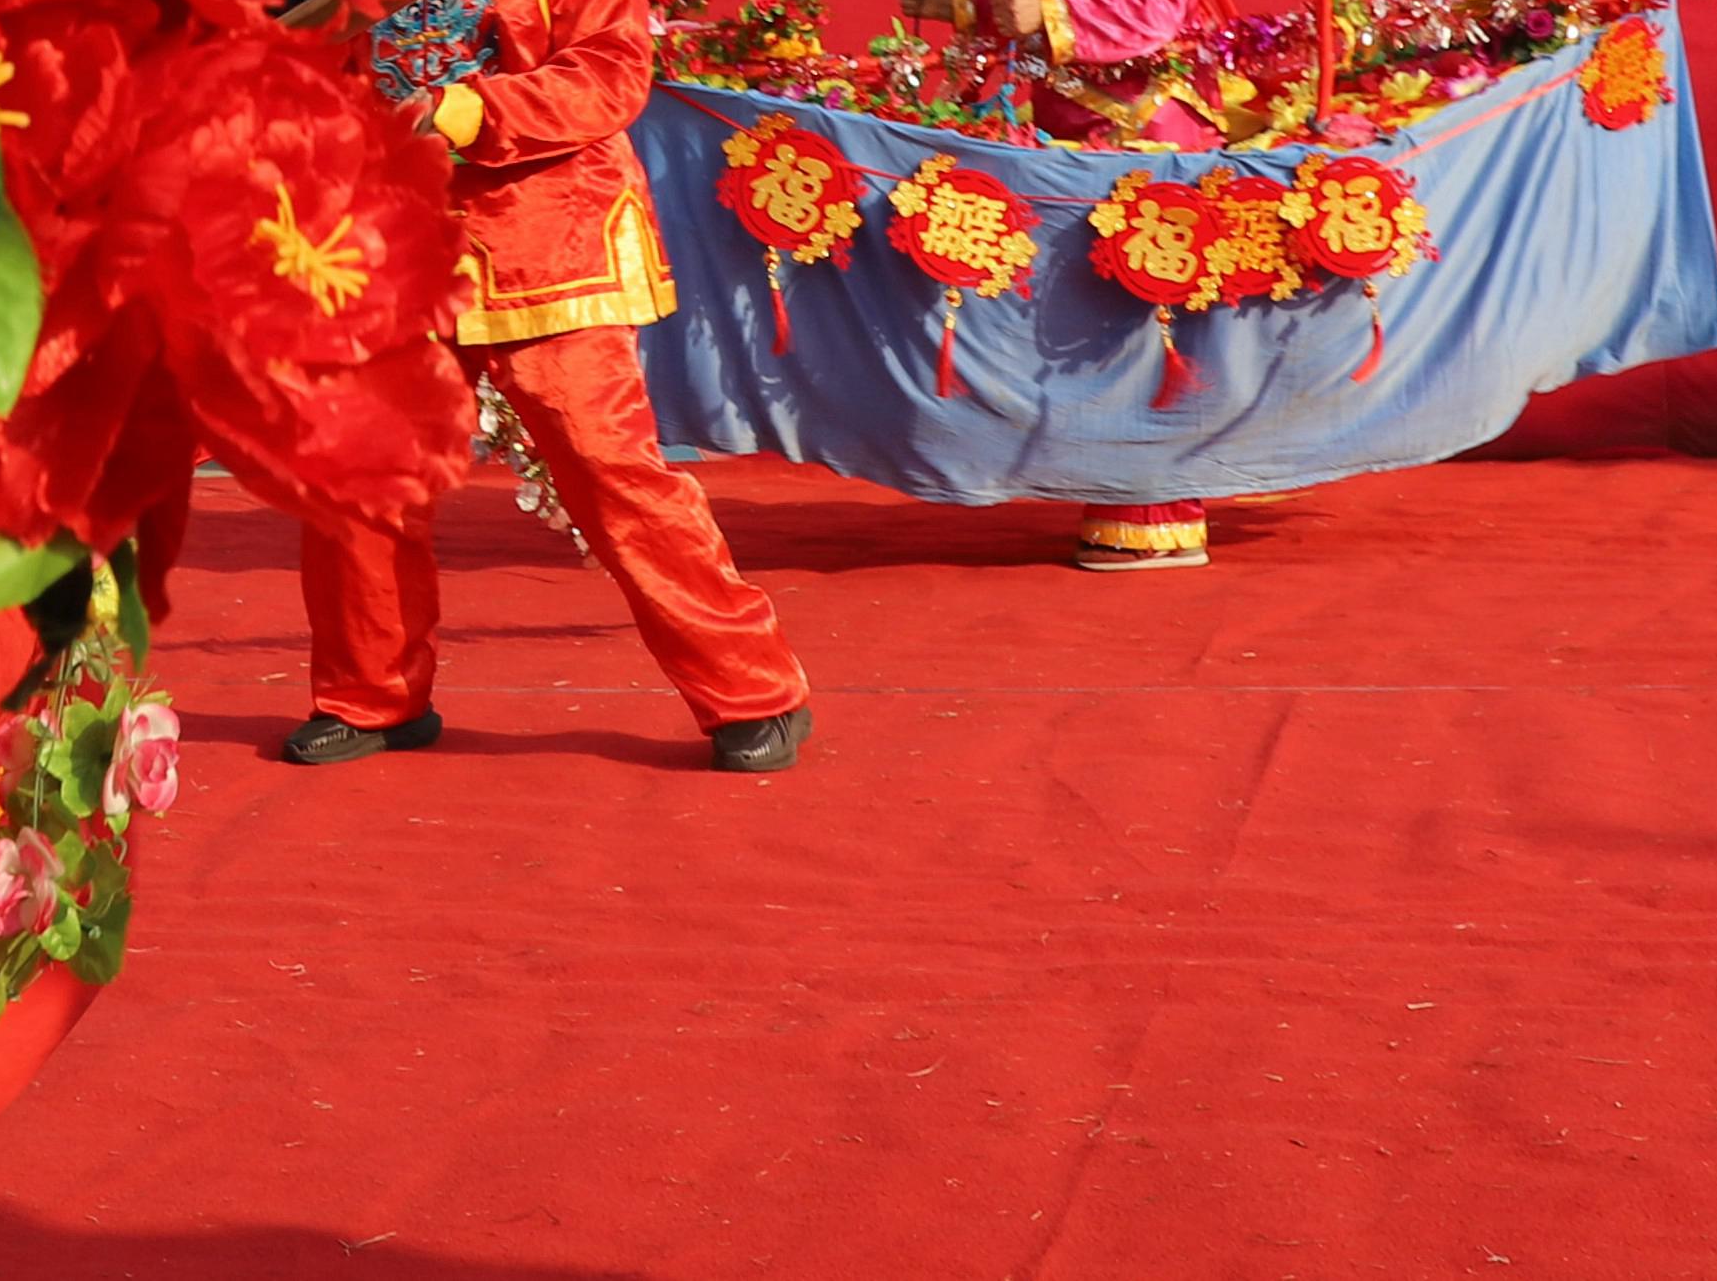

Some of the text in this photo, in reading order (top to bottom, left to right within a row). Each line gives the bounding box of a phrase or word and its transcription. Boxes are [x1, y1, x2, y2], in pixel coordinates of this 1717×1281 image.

[749, 143, 833, 234] 福
[1317, 175, 1394, 254] 福
[1120, 199, 1199, 284] 福
